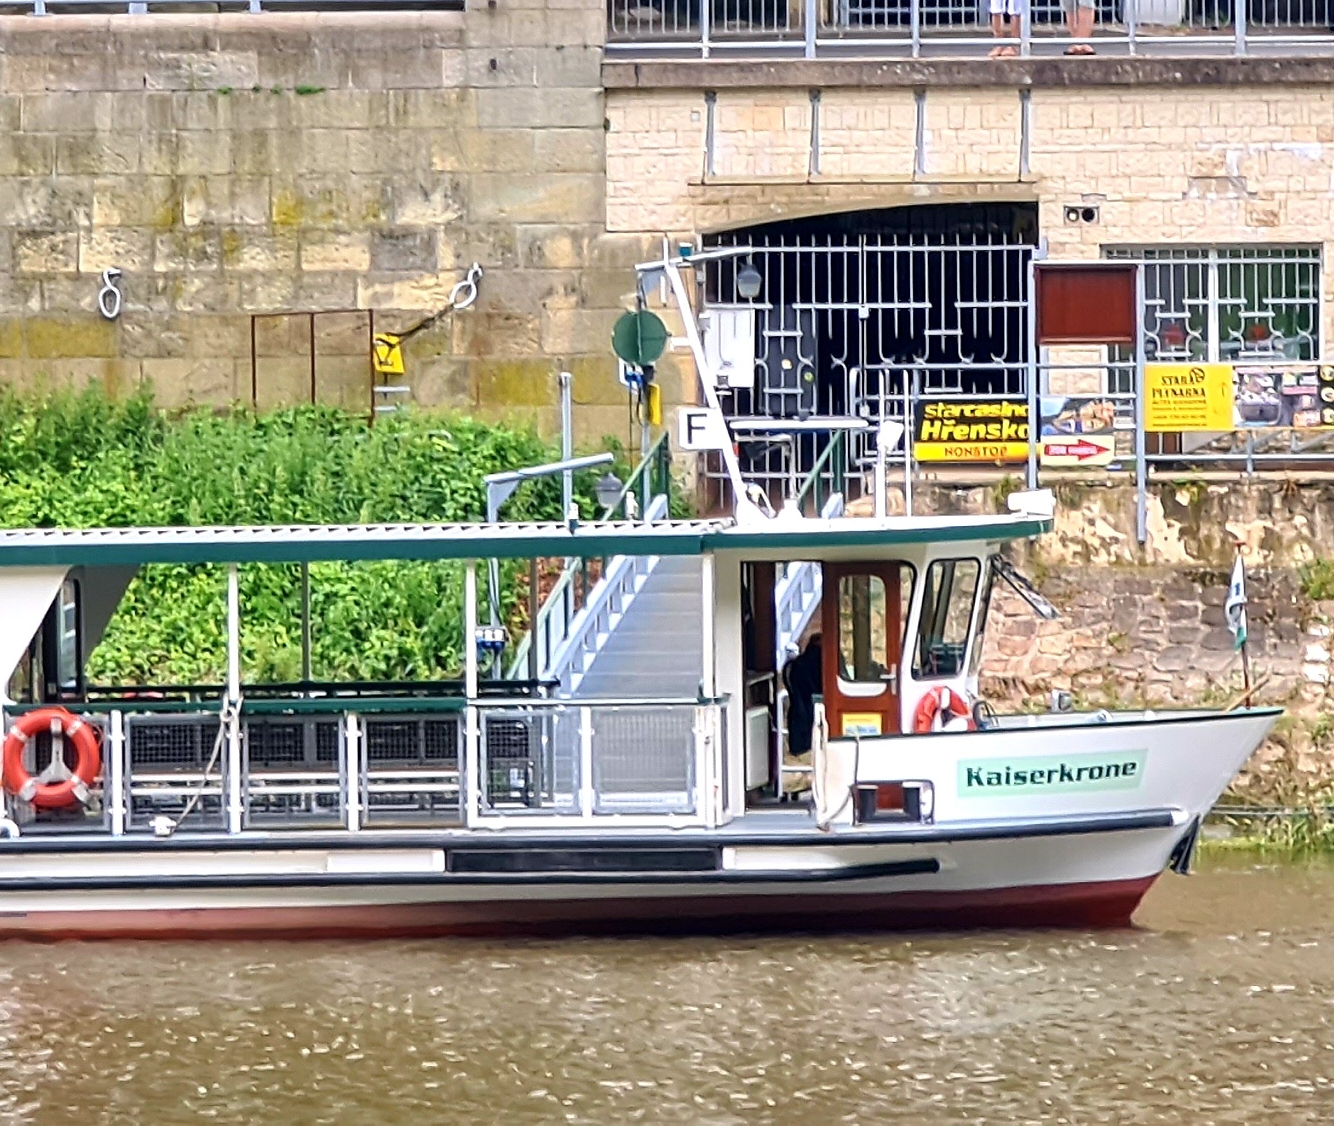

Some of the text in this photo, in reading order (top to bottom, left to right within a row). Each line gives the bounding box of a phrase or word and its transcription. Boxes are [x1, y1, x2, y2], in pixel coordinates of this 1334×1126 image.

[686, 413, 707, 444] F
[944, 445, 1008, 457] NONSTOP
[966, 763, 1137, 787] Kaiserkrone
